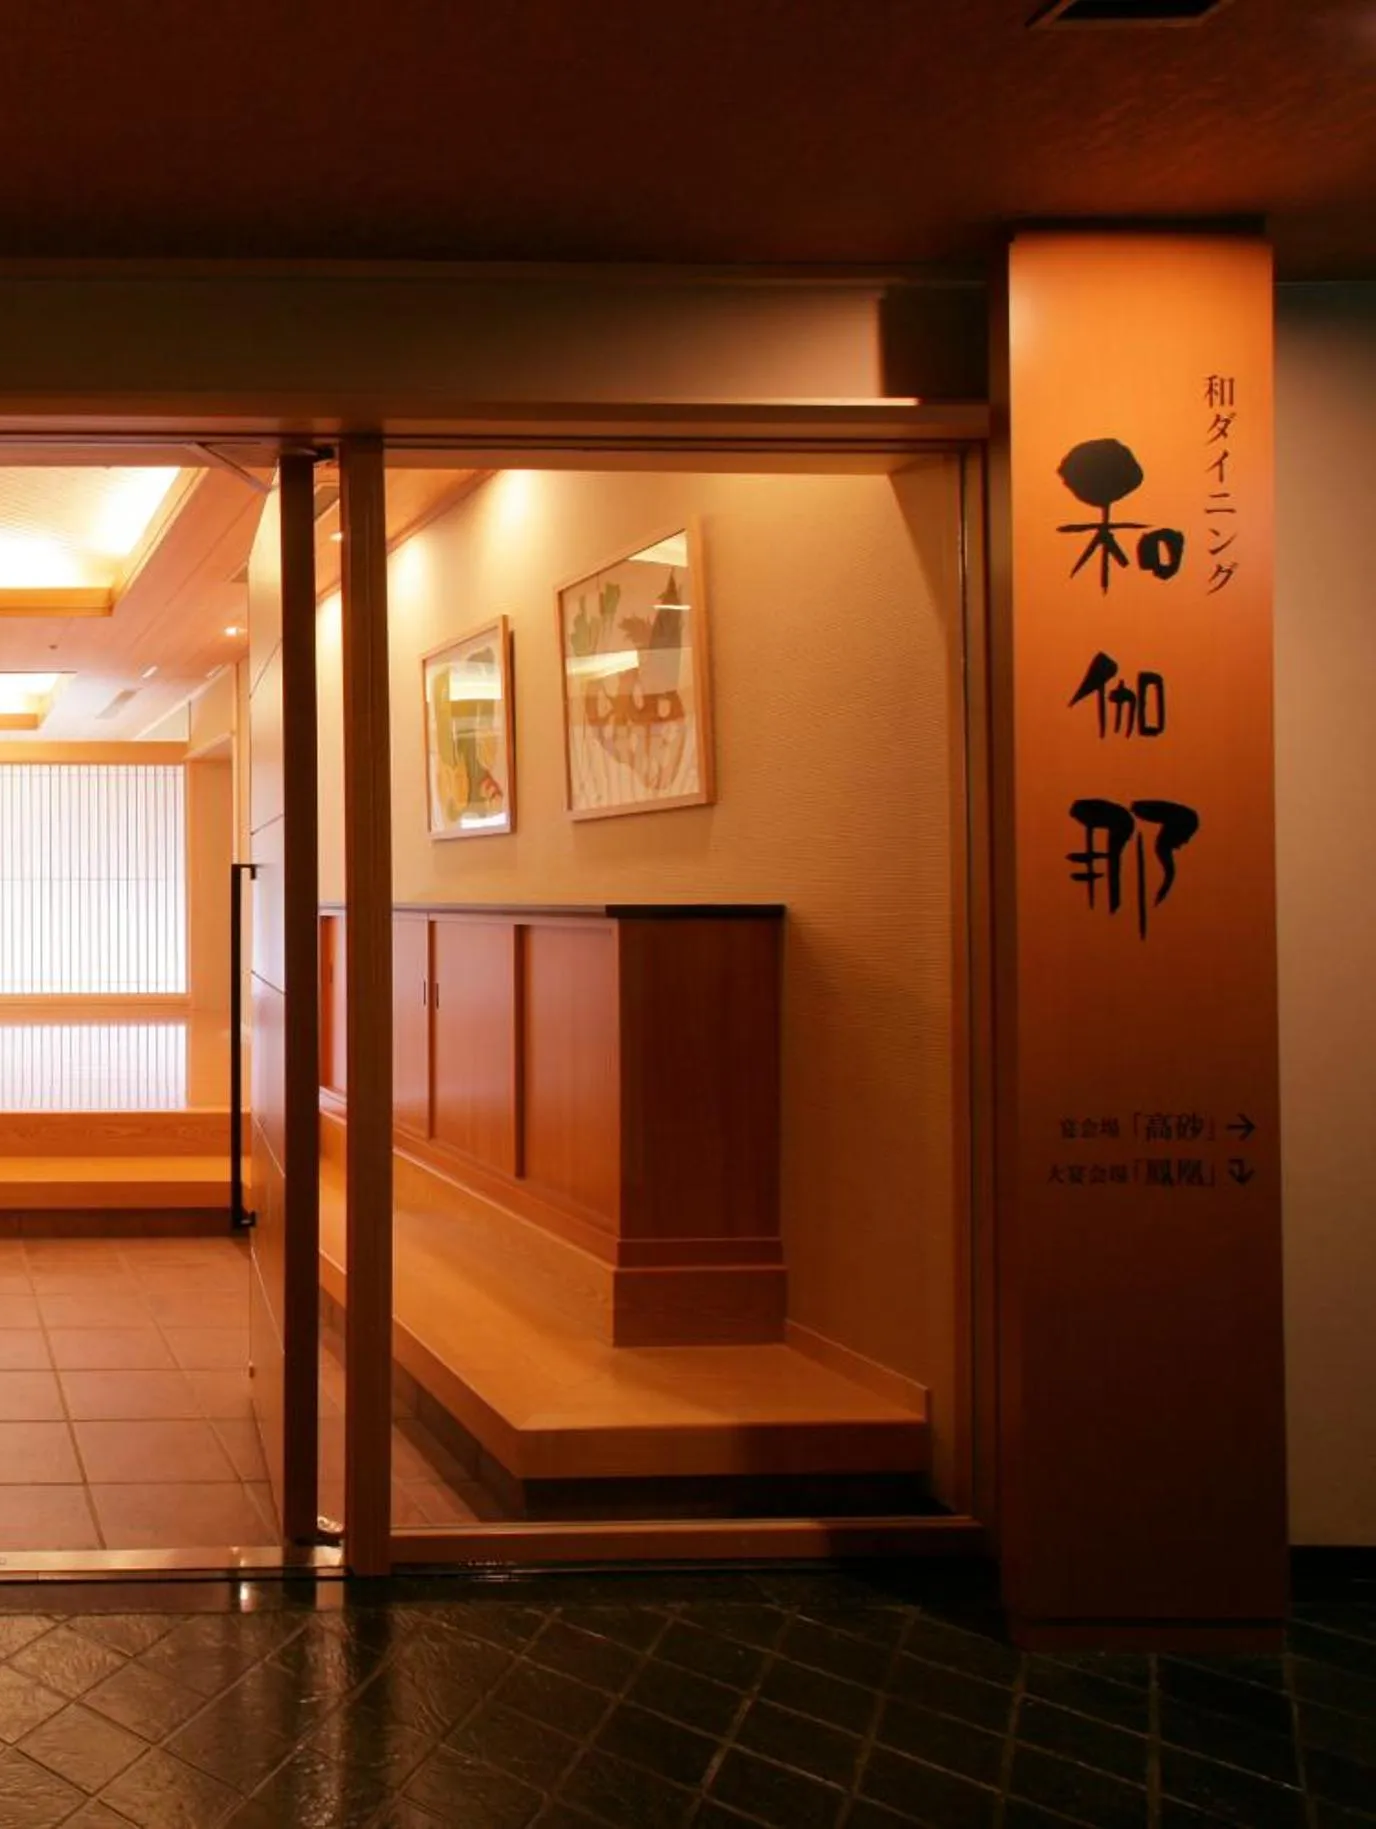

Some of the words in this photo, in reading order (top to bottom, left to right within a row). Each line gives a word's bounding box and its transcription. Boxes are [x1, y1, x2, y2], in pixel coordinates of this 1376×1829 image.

[1203, 374, 1238, 595] 和ダイニング
[1055, 438, 1200, 941] 和伽那
